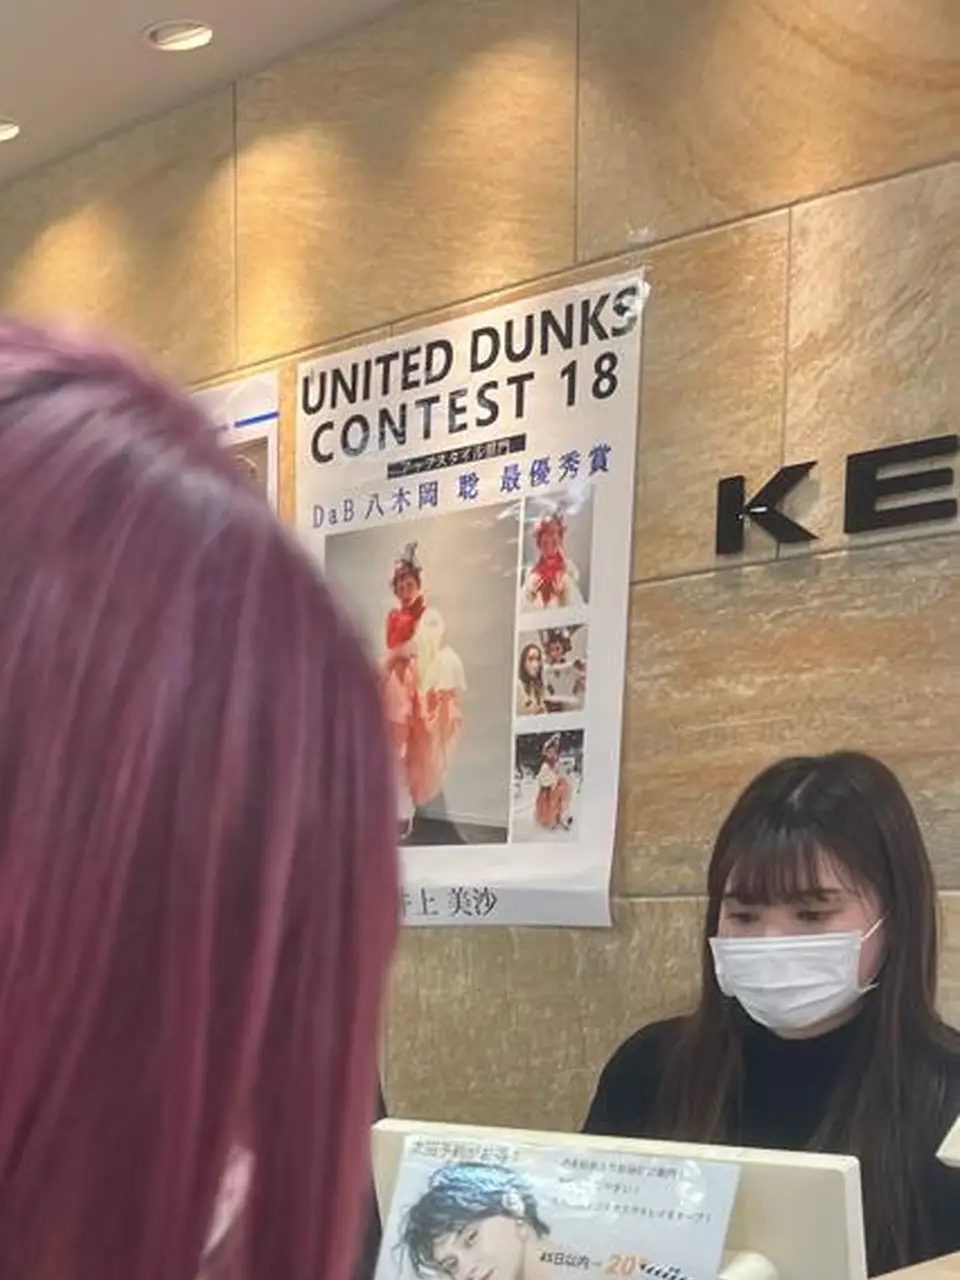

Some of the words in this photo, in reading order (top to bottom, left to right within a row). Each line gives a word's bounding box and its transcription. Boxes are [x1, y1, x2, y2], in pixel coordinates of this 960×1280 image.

[302, 339, 454, 415] UNITED
[470, 285, 639, 373] DUNKS
[311, 372, 535, 463] CONTEST
[560, 352, 619, 407] 18
[313, 499, 355, 529] DaB
[500, 443, 612, 493] 最優秀賞
